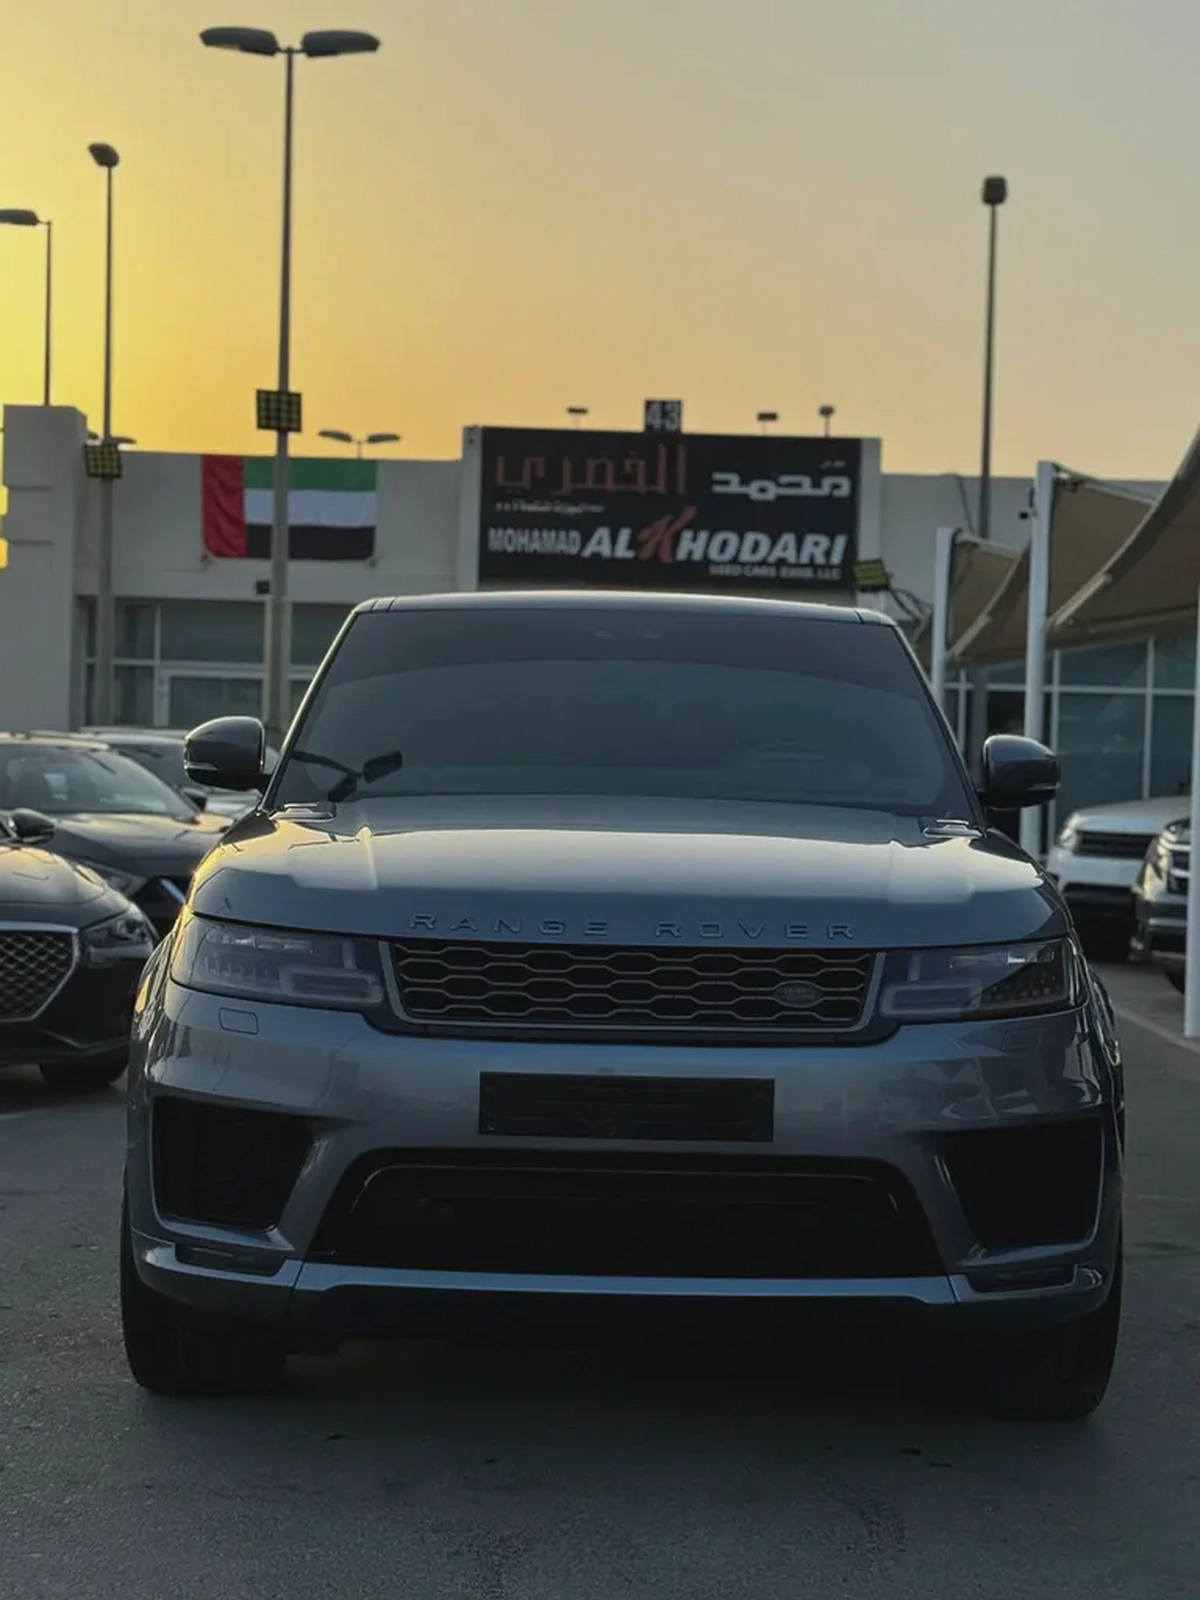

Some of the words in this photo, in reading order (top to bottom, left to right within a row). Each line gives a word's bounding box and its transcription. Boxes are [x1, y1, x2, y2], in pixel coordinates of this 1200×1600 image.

[647, 401, 680, 431] 43
[711, 472, 852, 501] محمد
[488, 527, 581, 555] MOHAMAD
[581, 527, 636, 559] AL
[408, 913, 607, 936] RANGE
[655, 921, 854, 939] ROVER
